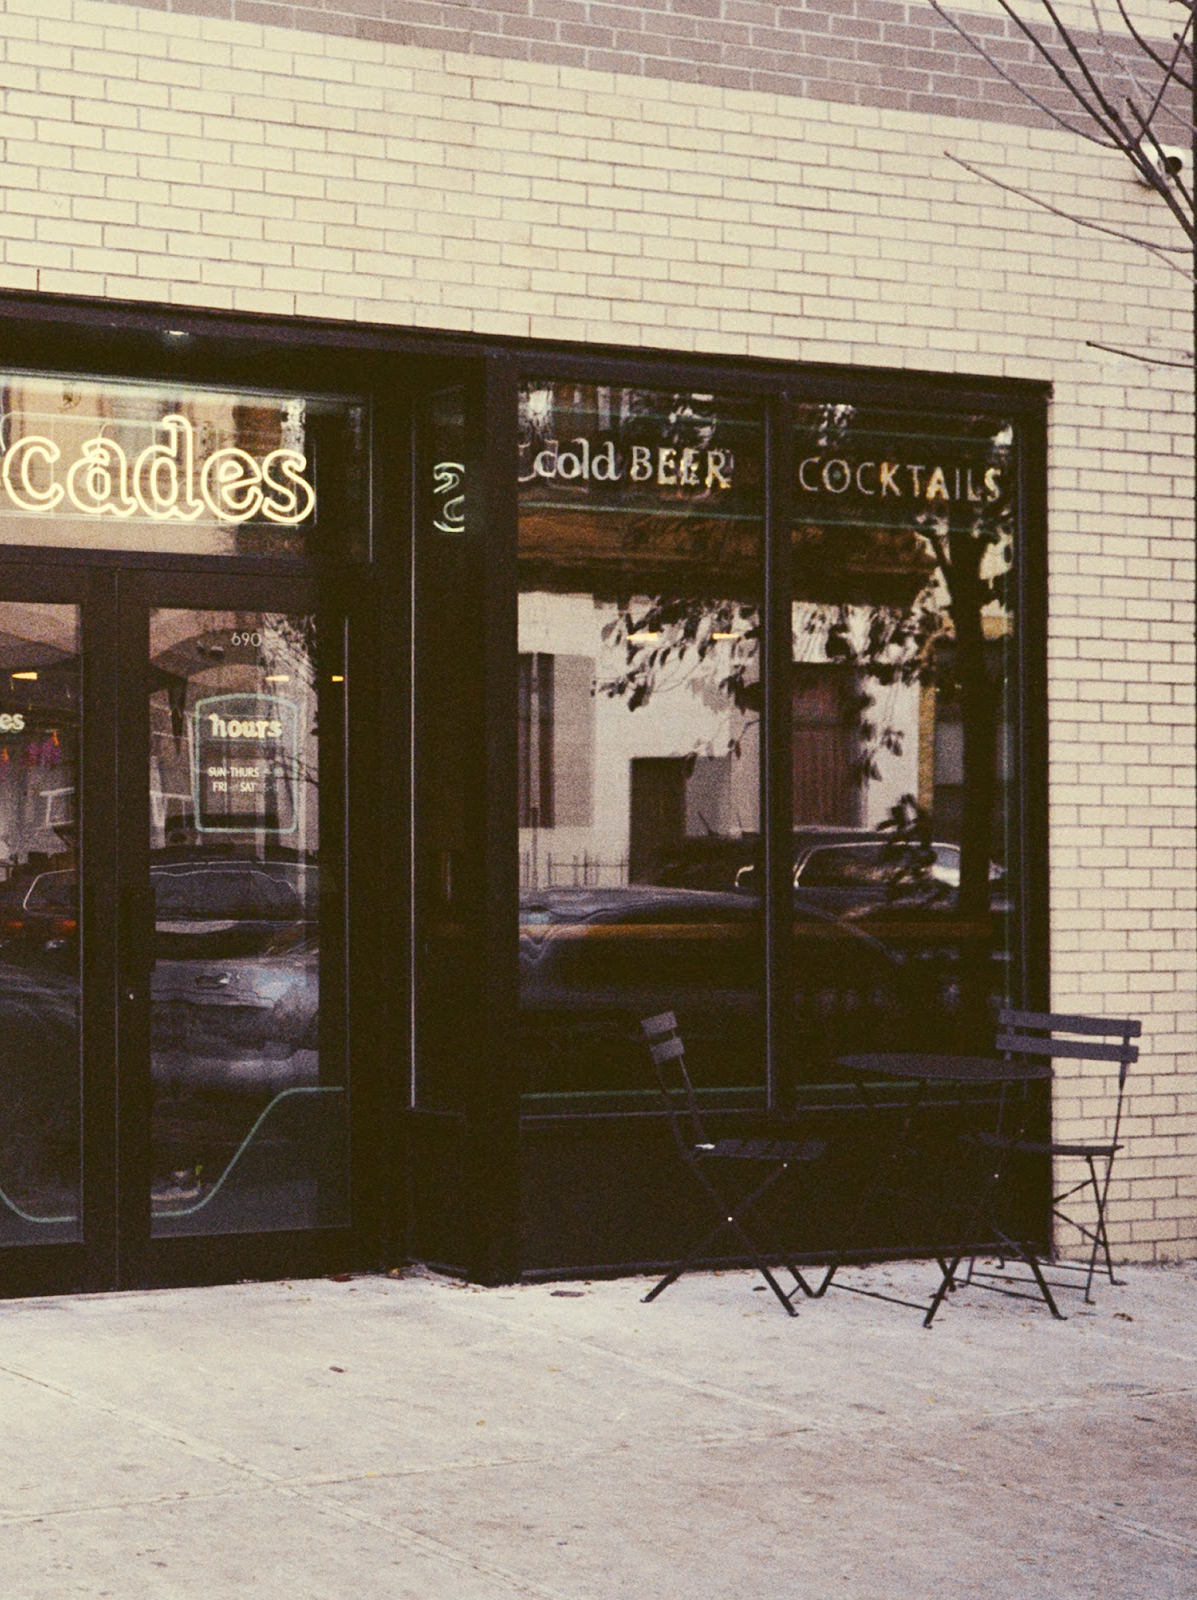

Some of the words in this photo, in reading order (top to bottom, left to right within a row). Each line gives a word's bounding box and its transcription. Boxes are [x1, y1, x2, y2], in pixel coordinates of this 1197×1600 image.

[534, 438, 622, 481] cold
[630, 445, 732, 490] BEER
[799, 456, 1002, 502] COCKTAILS
[231, 632, 262, 647] 690
[208, 713, 283, 738] hours
[212, 782, 227, 792] FRI
[240, 782, 256, 792] SAT
